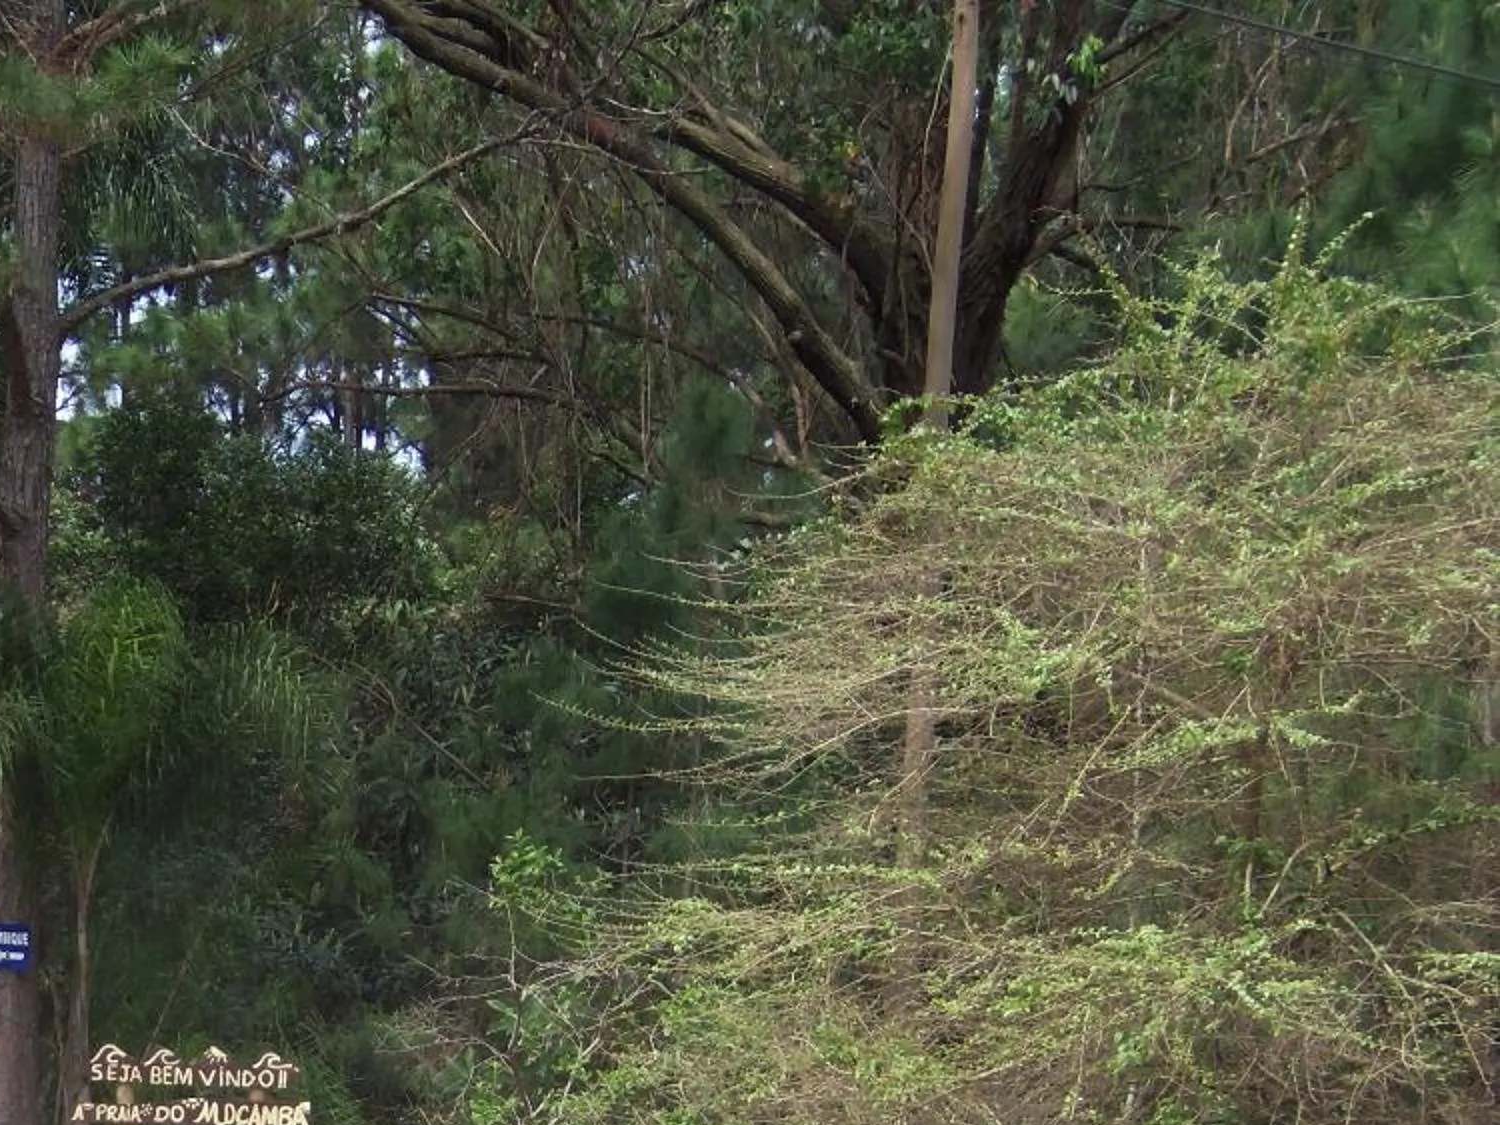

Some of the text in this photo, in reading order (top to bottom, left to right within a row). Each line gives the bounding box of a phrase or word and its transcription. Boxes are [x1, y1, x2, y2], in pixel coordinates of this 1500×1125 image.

[91, 1063, 143, 1083] SEJA
[150, 1065, 193, 1086] BEM
[72, 1102, 85, 1121] A
[95, 1103, 142, 1123] PRAIA
[153, 1104, 185, 1123] DO
